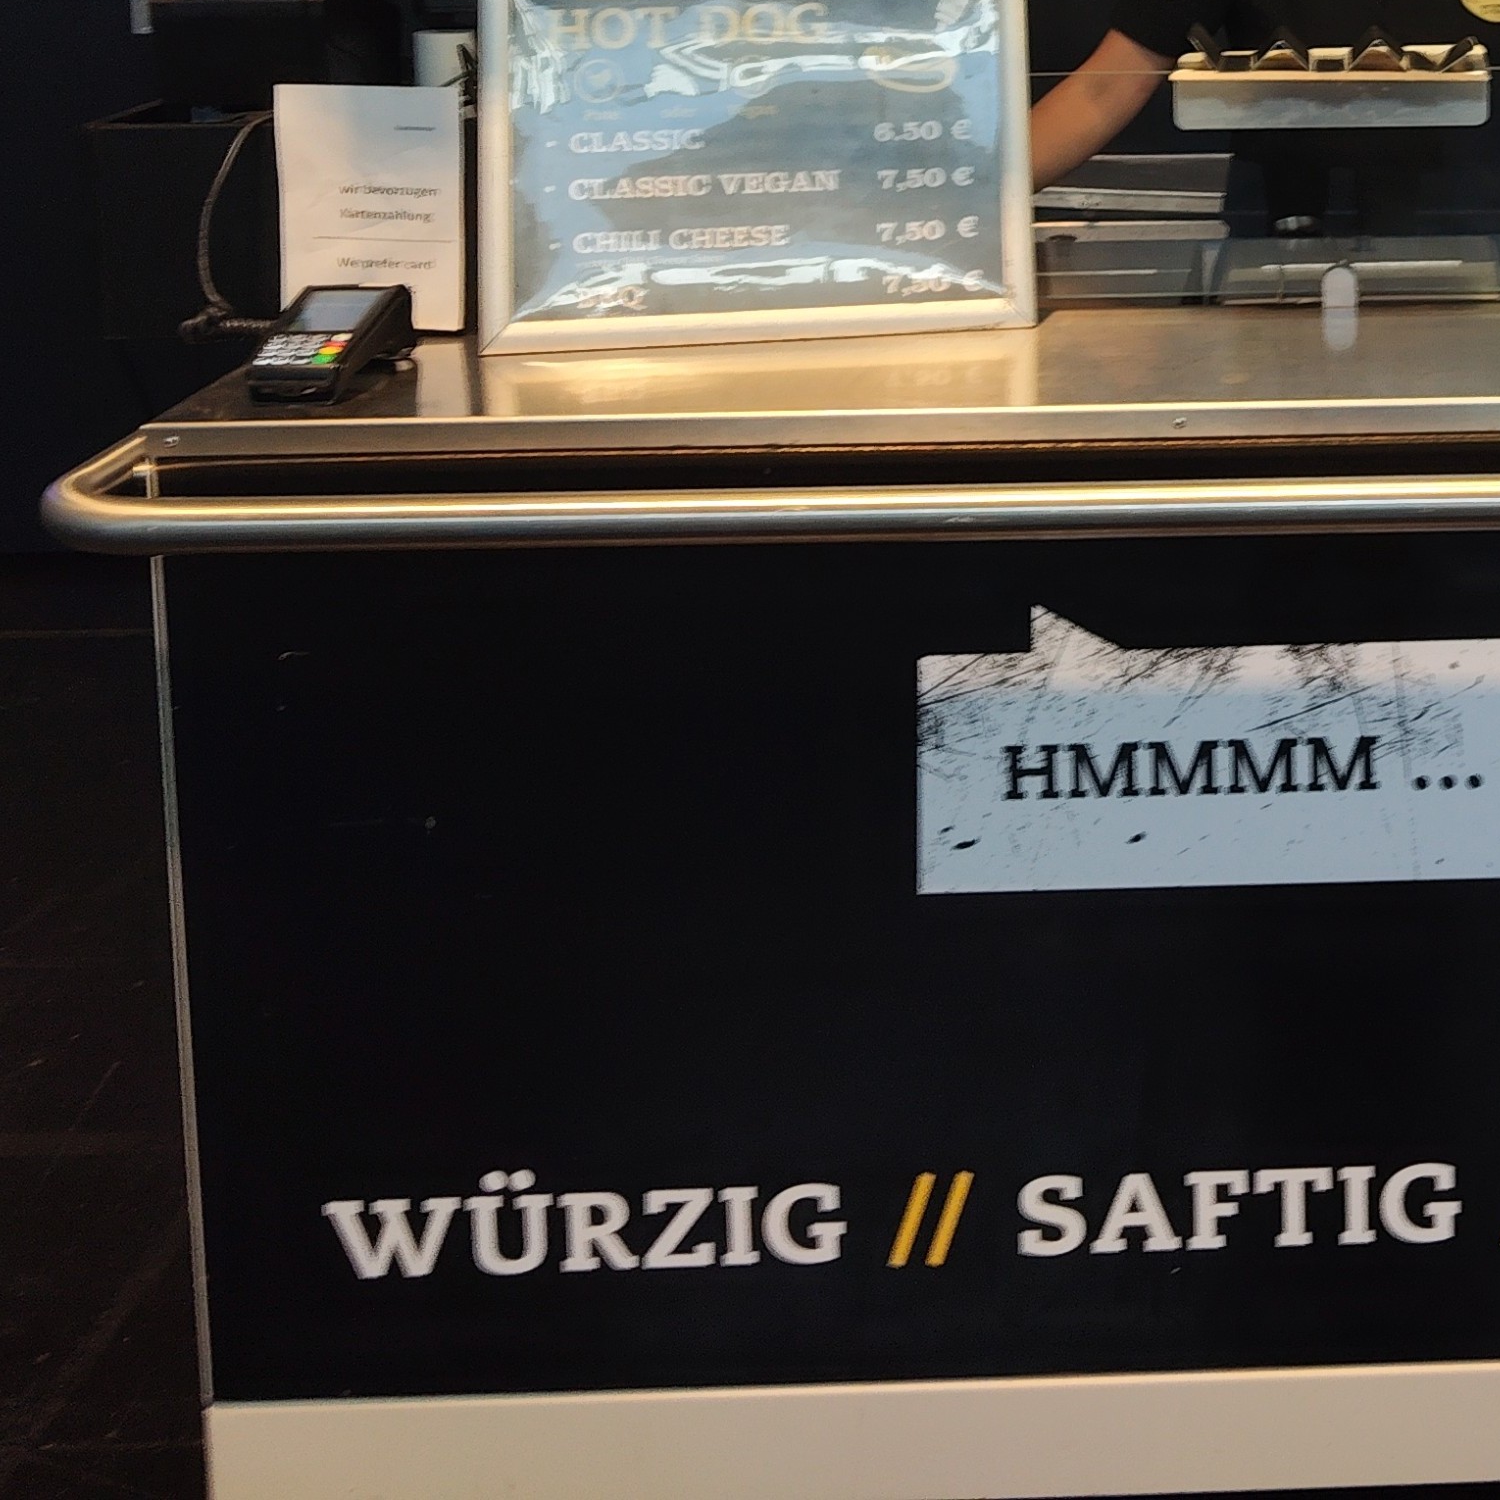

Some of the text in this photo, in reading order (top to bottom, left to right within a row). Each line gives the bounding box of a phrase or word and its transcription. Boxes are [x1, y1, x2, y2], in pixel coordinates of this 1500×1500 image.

[550, 1, 830, 50] HOT DOG
[568, 129, 706, 154] CLASSIC
[950, 118, 973, 140] €
[568, 174, 712, 200] CLASSIC
[717, 169, 843, 195] VEGAN
[876, 167, 947, 192] 7,50
[951, 165, 976, 187] €
[572, 229, 663, 254] CHILI
[668, 224, 791, 250] CHEESE
[876, 219, 946, 245] 7,50
[956, 215, 980, 238] €
[1001, 735, 1382, 801] HMMMM
[320, 1168, 849, 1280] WÜRZIG
[1014, 1161, 1463, 1259] SAFTIG
